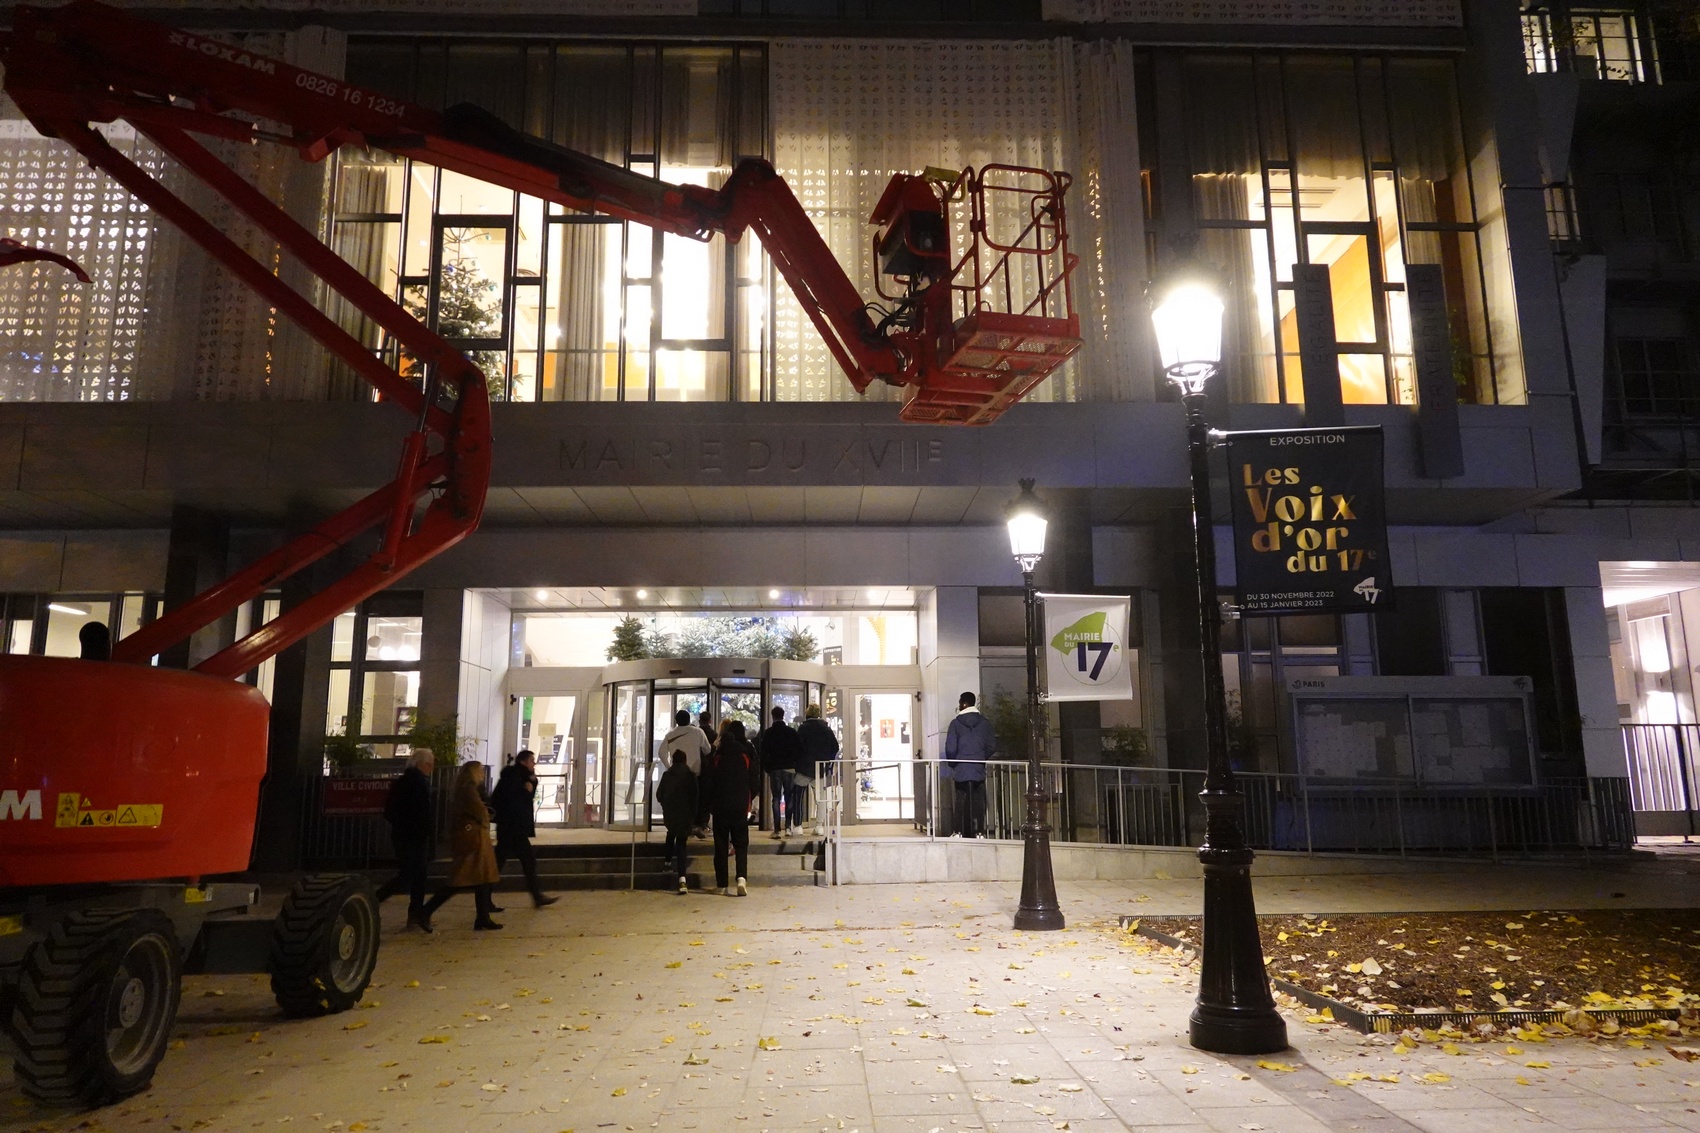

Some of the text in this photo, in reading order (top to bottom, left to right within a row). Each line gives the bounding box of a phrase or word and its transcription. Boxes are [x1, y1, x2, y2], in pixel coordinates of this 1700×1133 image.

[186, 37, 406, 118] LOXAM 0826 16 1234
[1269, 434, 1346, 446] EXPOSITION
[559, 439, 722, 472] MAIRIE
[748, 439, 806, 472] DU
[1242, 463, 1301, 486] Les
[1244, 485, 1357, 523] Voix
[1251, 521, 1350, 553] d'or
[1286, 550, 1329, 573] du
[1246, 593, 1258, 601] DU
[1271, 591, 1315, 600] NOVEMBRE
[1316, 590, 1335, 598] 2022
[1269, 600, 1303, 609] JANVIER
[1304, 599, 1324, 607] 2023
[1064, 632, 1101, 641] MAIRIE
[1302, 680, 1326, 689] PARIS
[332, 781, 356, 791] VILLE
